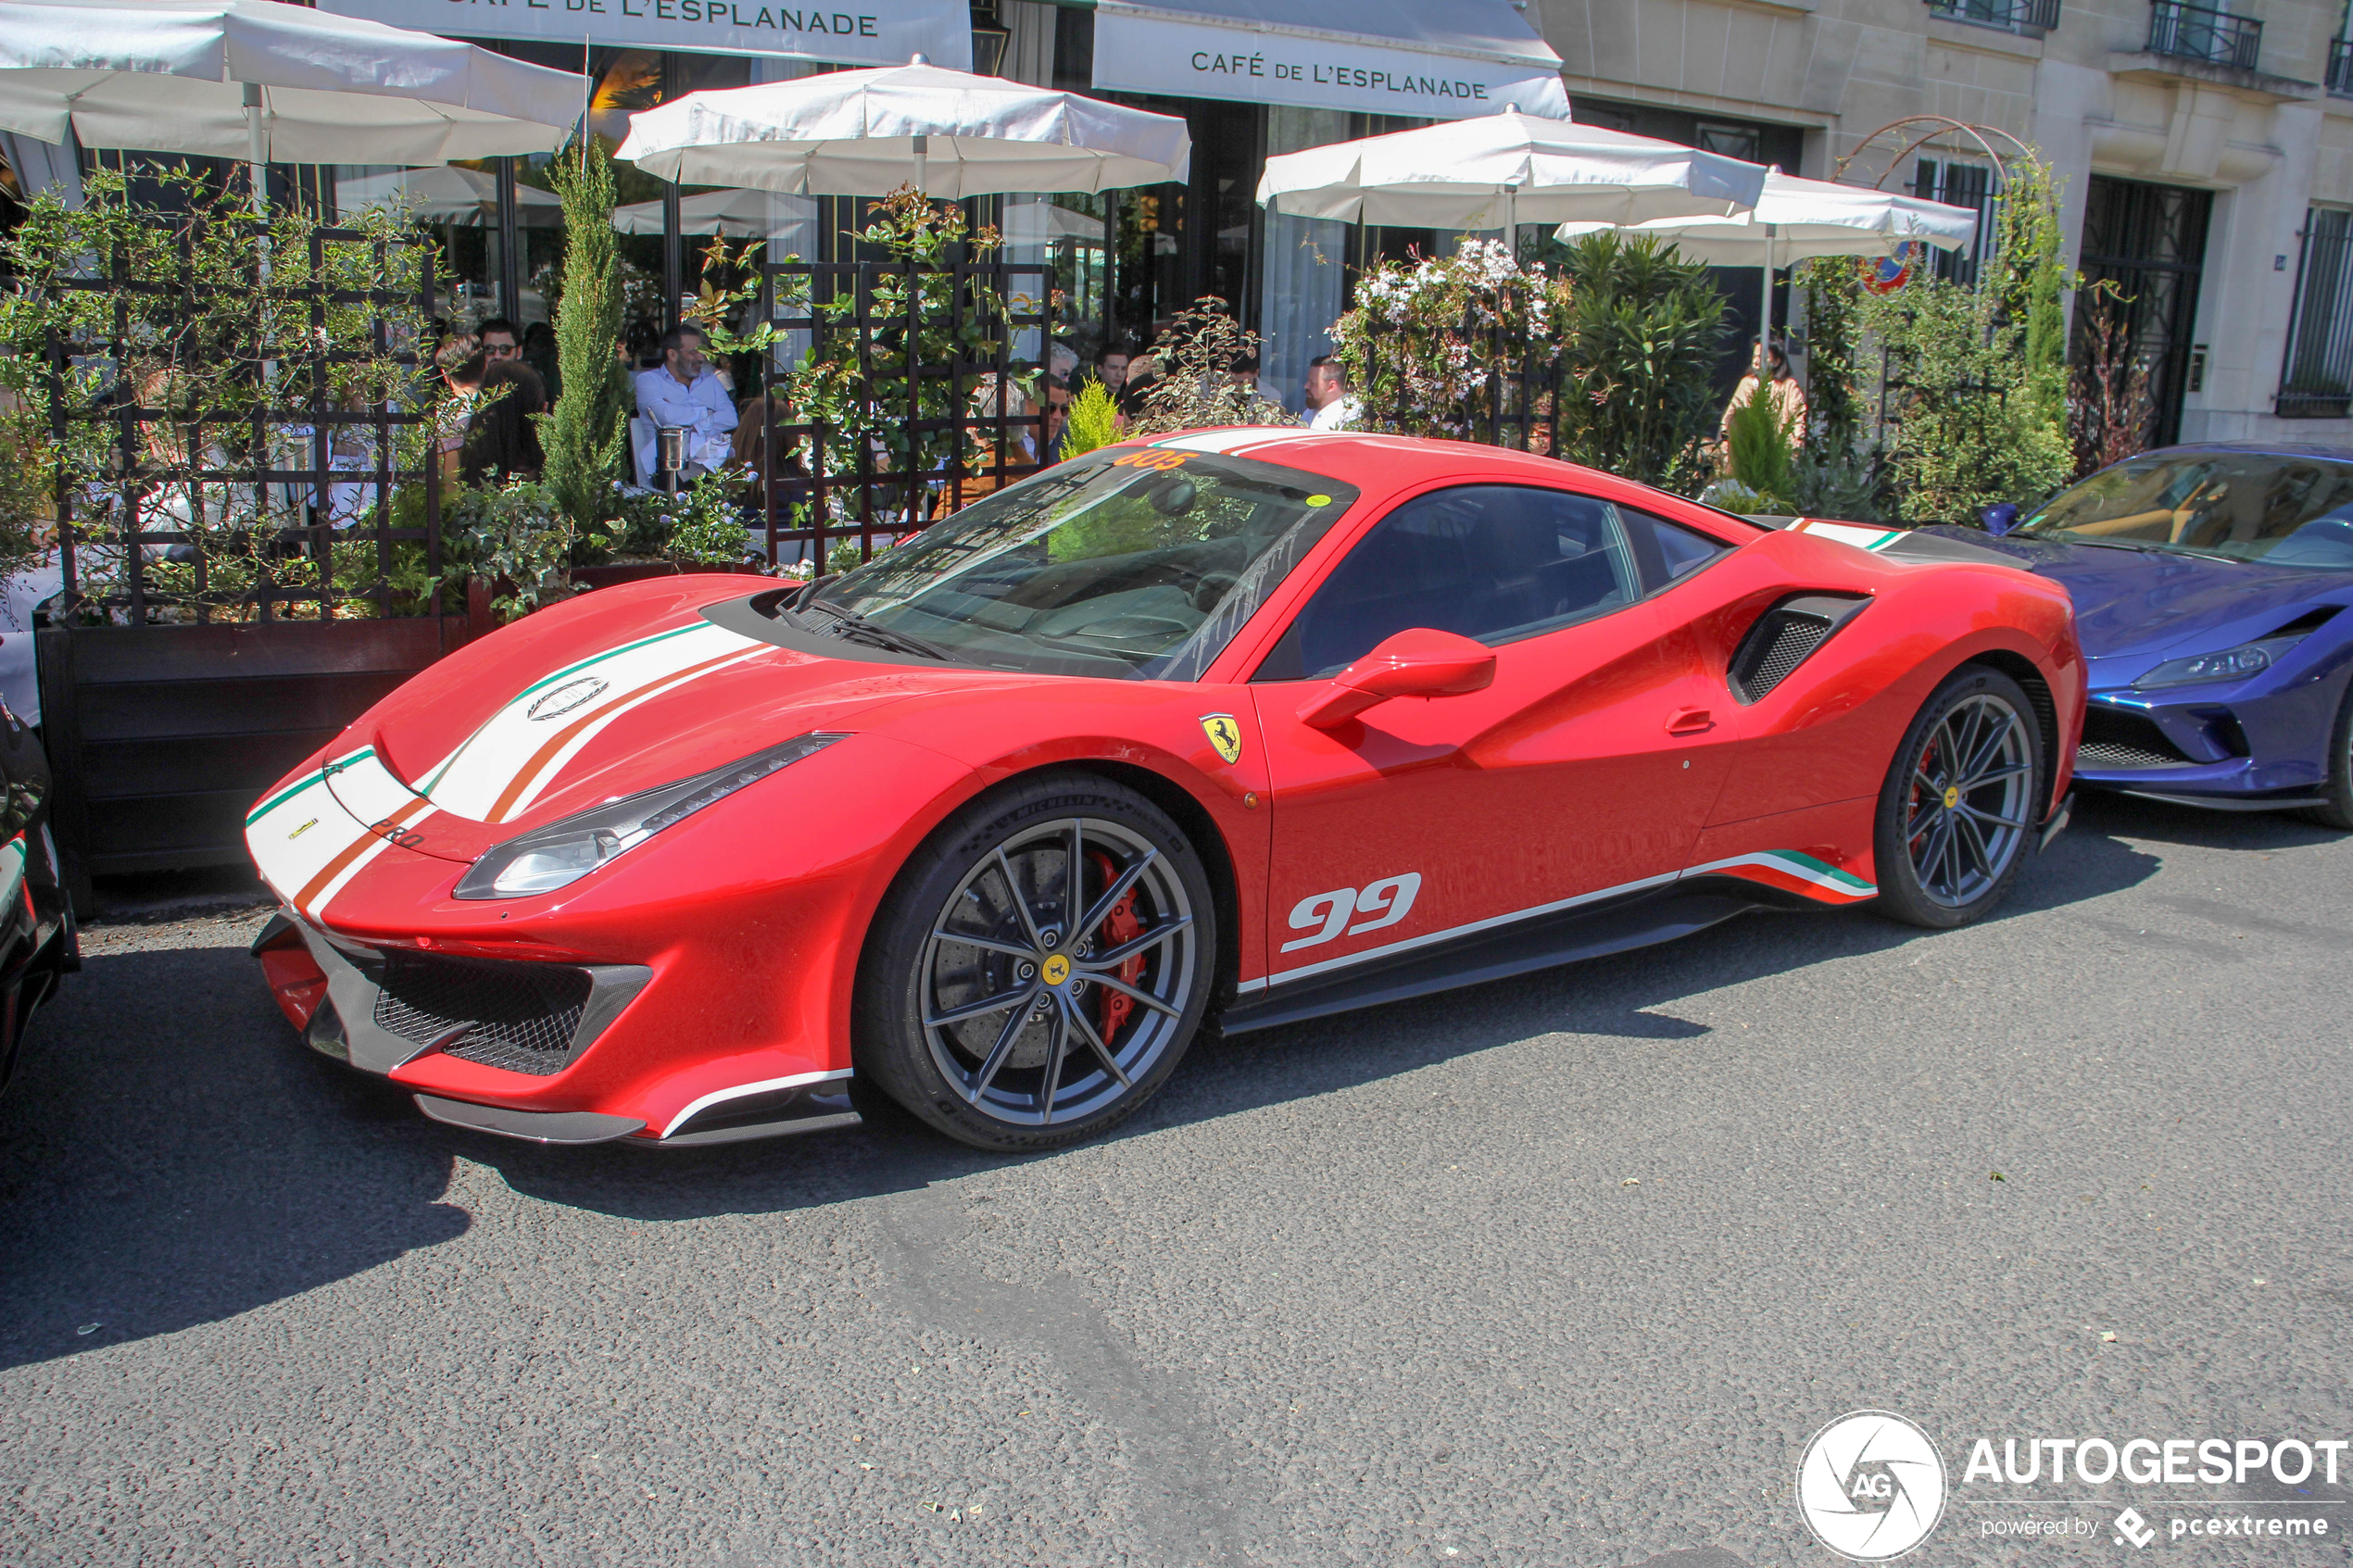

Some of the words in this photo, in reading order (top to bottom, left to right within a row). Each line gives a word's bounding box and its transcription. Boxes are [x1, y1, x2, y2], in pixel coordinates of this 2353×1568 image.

[566, 0, 606, 14] DE
[1191, 52, 1265, 77] CAFÉ
[1276, 63, 1302, 81] DE
[1114, 449, 1202, 470] 605
[1016, 794, 1096, 822] MICHELIN
[370, 819, 425, 848] PRO
[1280, 872, 1422, 953] 99
